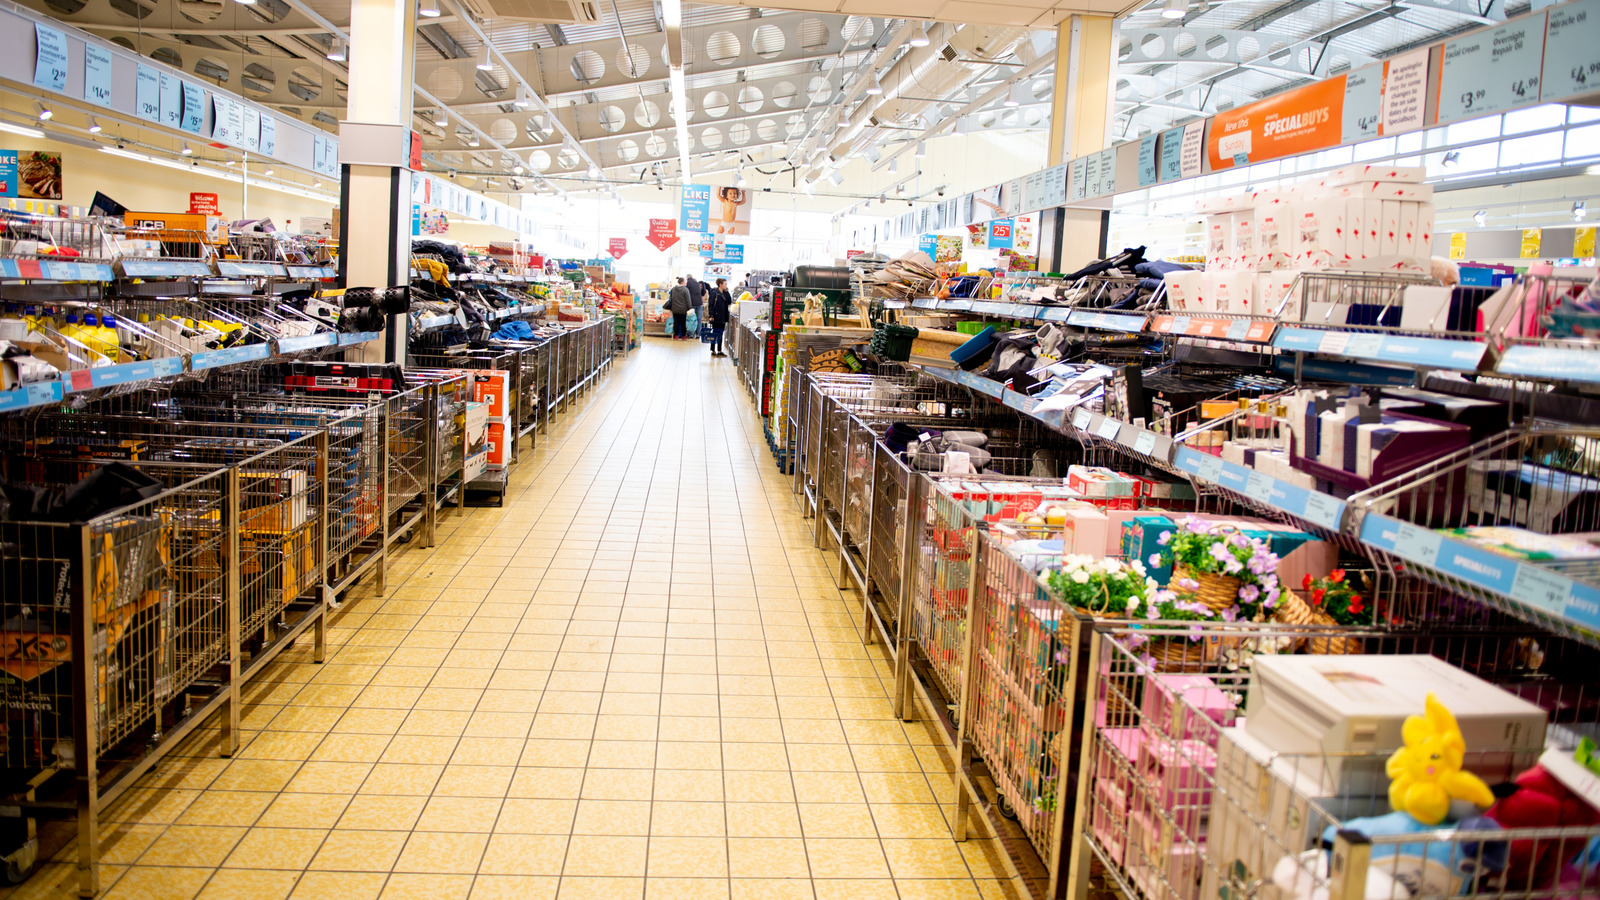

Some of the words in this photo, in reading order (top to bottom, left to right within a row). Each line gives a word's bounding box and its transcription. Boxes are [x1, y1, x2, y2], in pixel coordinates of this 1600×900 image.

[1550, 16, 1575, 30] Miracle
[1576, 11, 1586, 22] Oil
[40, 41, 59, 51] Household
[1493, 30, 1525, 46] Overnight
[41, 49, 60, 58] Assortment
[1446, 49, 1460, 60] Facial
[1462, 44, 1480, 56] Cream
[1492, 45, 1513, 57] Repair
[1514, 41, 1523, 51] Oil
[87, 52, 109, 64] Transportation
[52, 68, 66, 81] £2.99
[1400, 62, 1422, 72] apologise
[1571, 62, 1600, 84] £4.99
[92, 86, 110, 99] £14.99
[1512, 77, 1538, 96] £4.99
[1391, 90, 1411, 100] changes
[1460, 90, 1486, 108] £3.99
[1224, 122, 1238, 132] New
[1238, 116, 1248, 128] this
[1264, 106, 1329, 137] SPECIALBUYS
[1224, 139, 1244, 152] Sunday
[684, 190, 708, 200] LIKE
[140, 220, 165, 230] JCB
[774, 291, 782, 329] FERREX
[766, 334, 776, 371] FERREX
